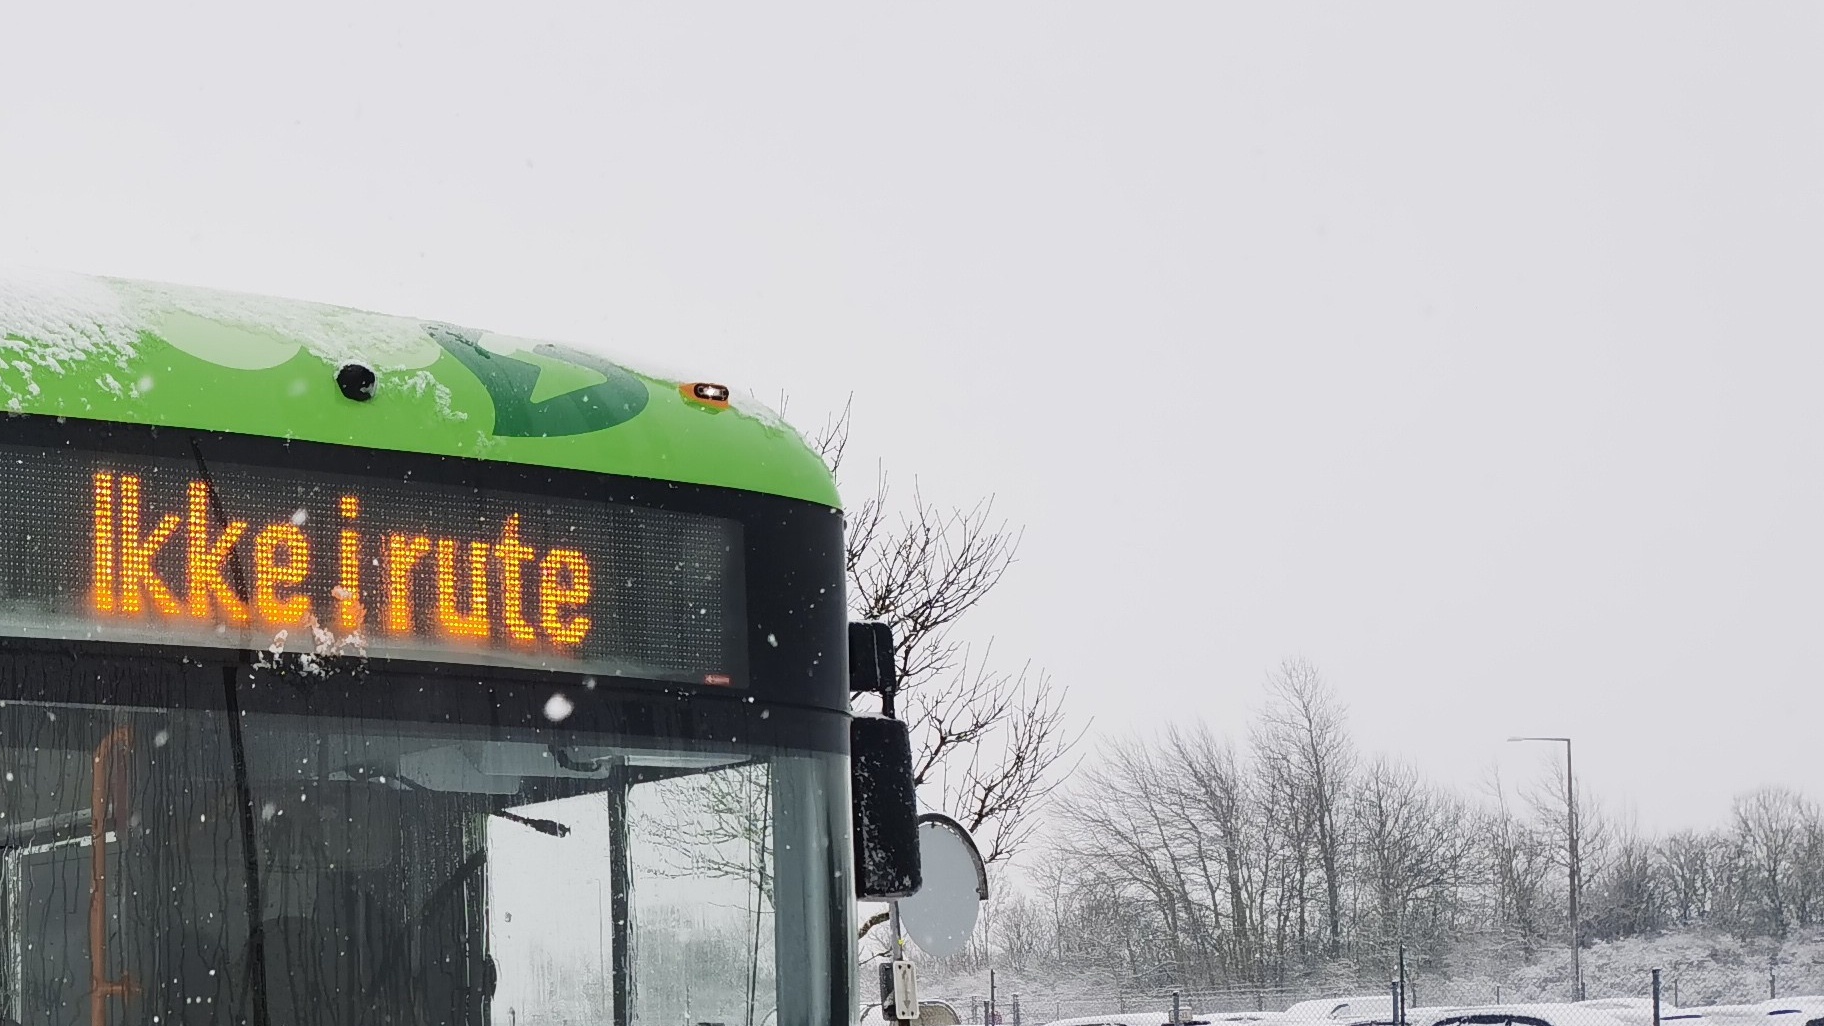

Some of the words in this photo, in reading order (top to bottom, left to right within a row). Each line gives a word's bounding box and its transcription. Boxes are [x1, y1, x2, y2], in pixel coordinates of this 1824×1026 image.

[92, 472, 309, 625] Ikke
[337, 496, 363, 628] i
[385, 512, 593, 645] rute
